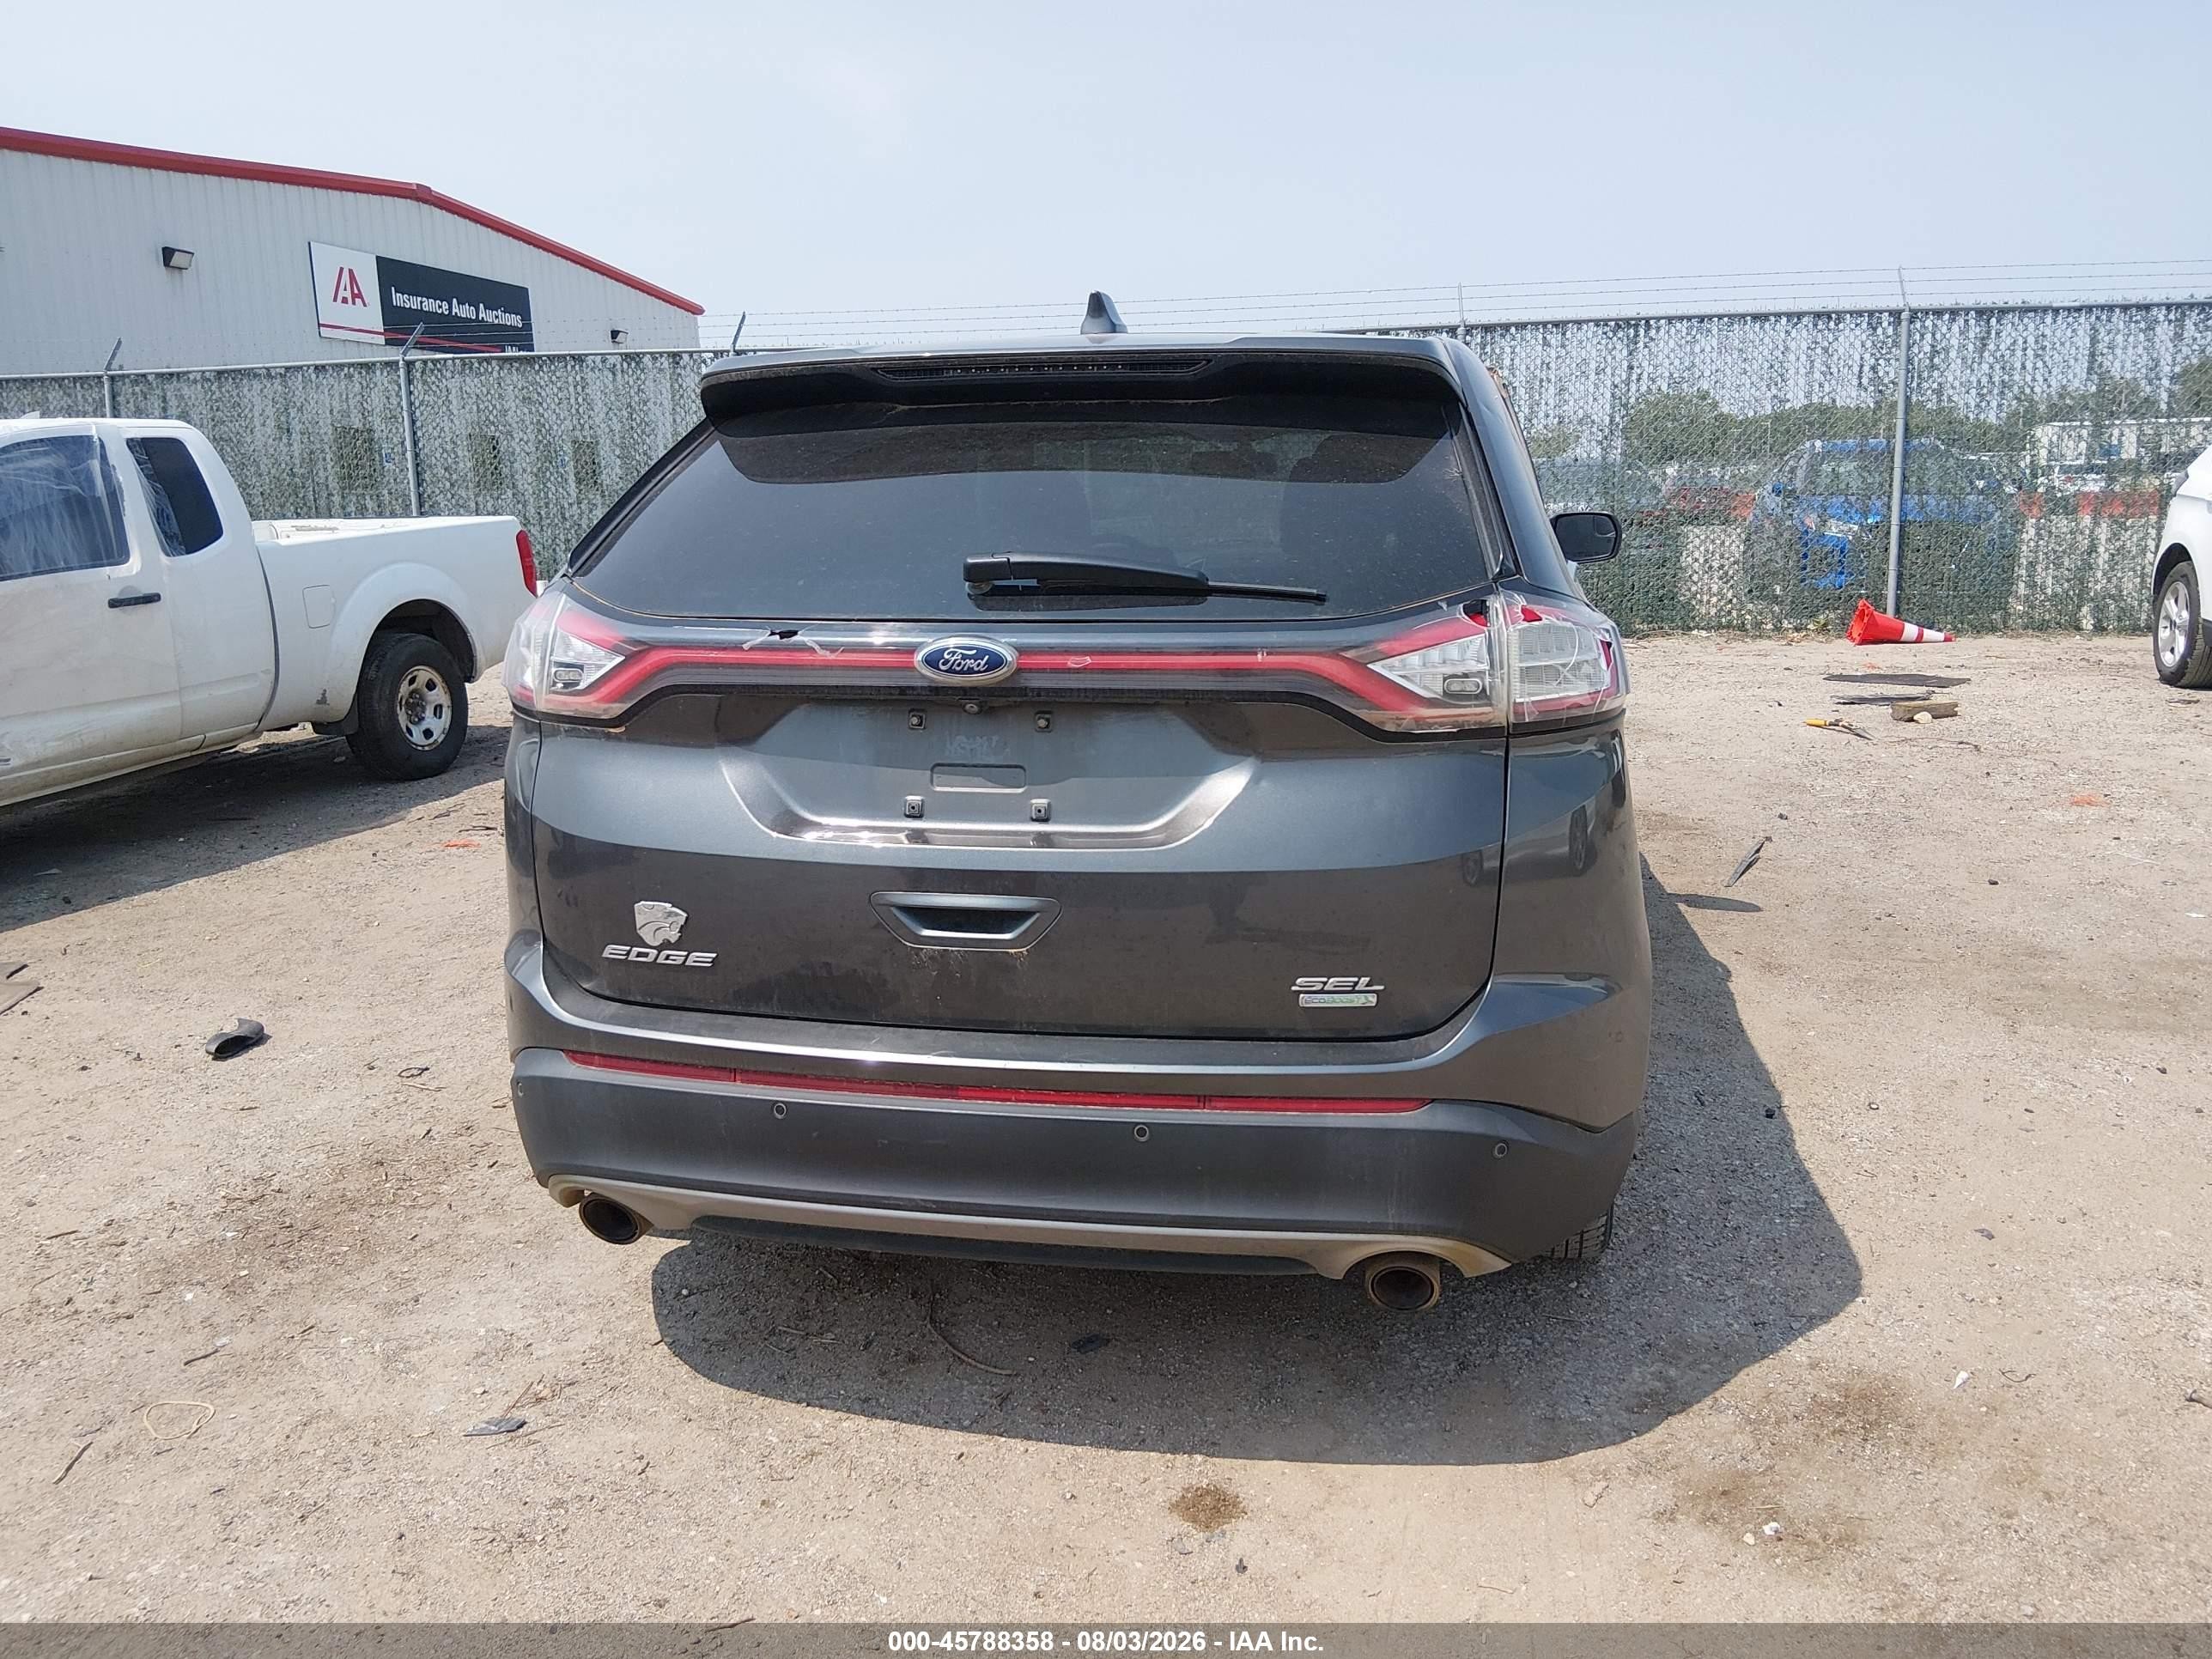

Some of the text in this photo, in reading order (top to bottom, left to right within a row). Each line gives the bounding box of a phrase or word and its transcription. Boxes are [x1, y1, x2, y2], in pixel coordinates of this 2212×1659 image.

[392, 287, 523, 328] Insurance Auto Auctions
[939, 648, 989, 672] Ford
[601, 945, 718, 967] EDGE
[1291, 977, 1385, 991] SEL
